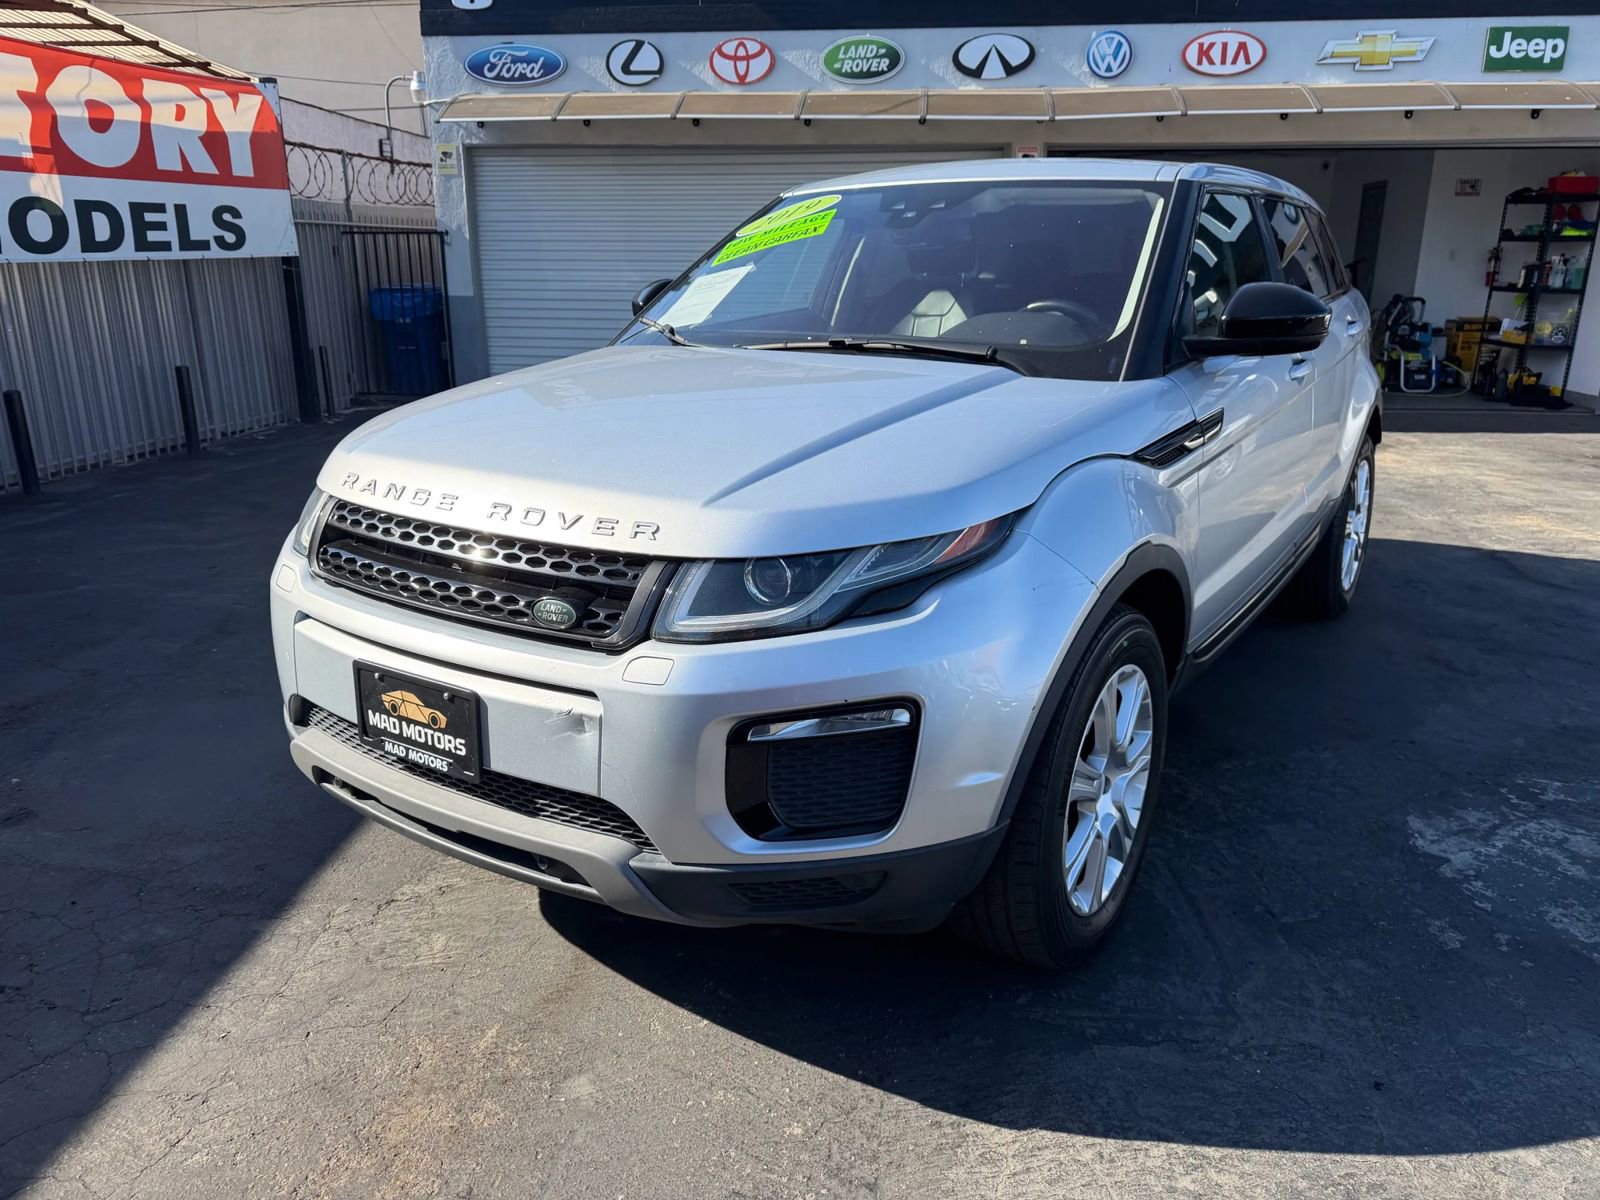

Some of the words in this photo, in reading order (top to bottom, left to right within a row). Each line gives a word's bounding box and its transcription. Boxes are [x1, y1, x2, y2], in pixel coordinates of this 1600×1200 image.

[838, 44, 877, 59] LAND
[1196, 41, 1252, 66] KIA
[1489, 31, 1565, 63] Jeep
[484, 49, 545, 78] Ford
[842, 58, 890, 72] ROVER
[0, 196, 247, 254] ODELS
[761, 213, 829, 237] MILEAGE
[716, 242, 760, 262] CLEAN
[762, 225, 821, 248] CARFAX
[341, 471, 459, 512] RANGE
[486, 502, 662, 541] ROVER
[540, 602, 562, 614] LAND
[542, 611, 569, 623] ROVER
[368, 709, 400, 734] MAD
[401, 720, 467, 756] MOTORS
[384, 741, 406, 757] MAD
[408, 749, 449, 772] MOTORS
